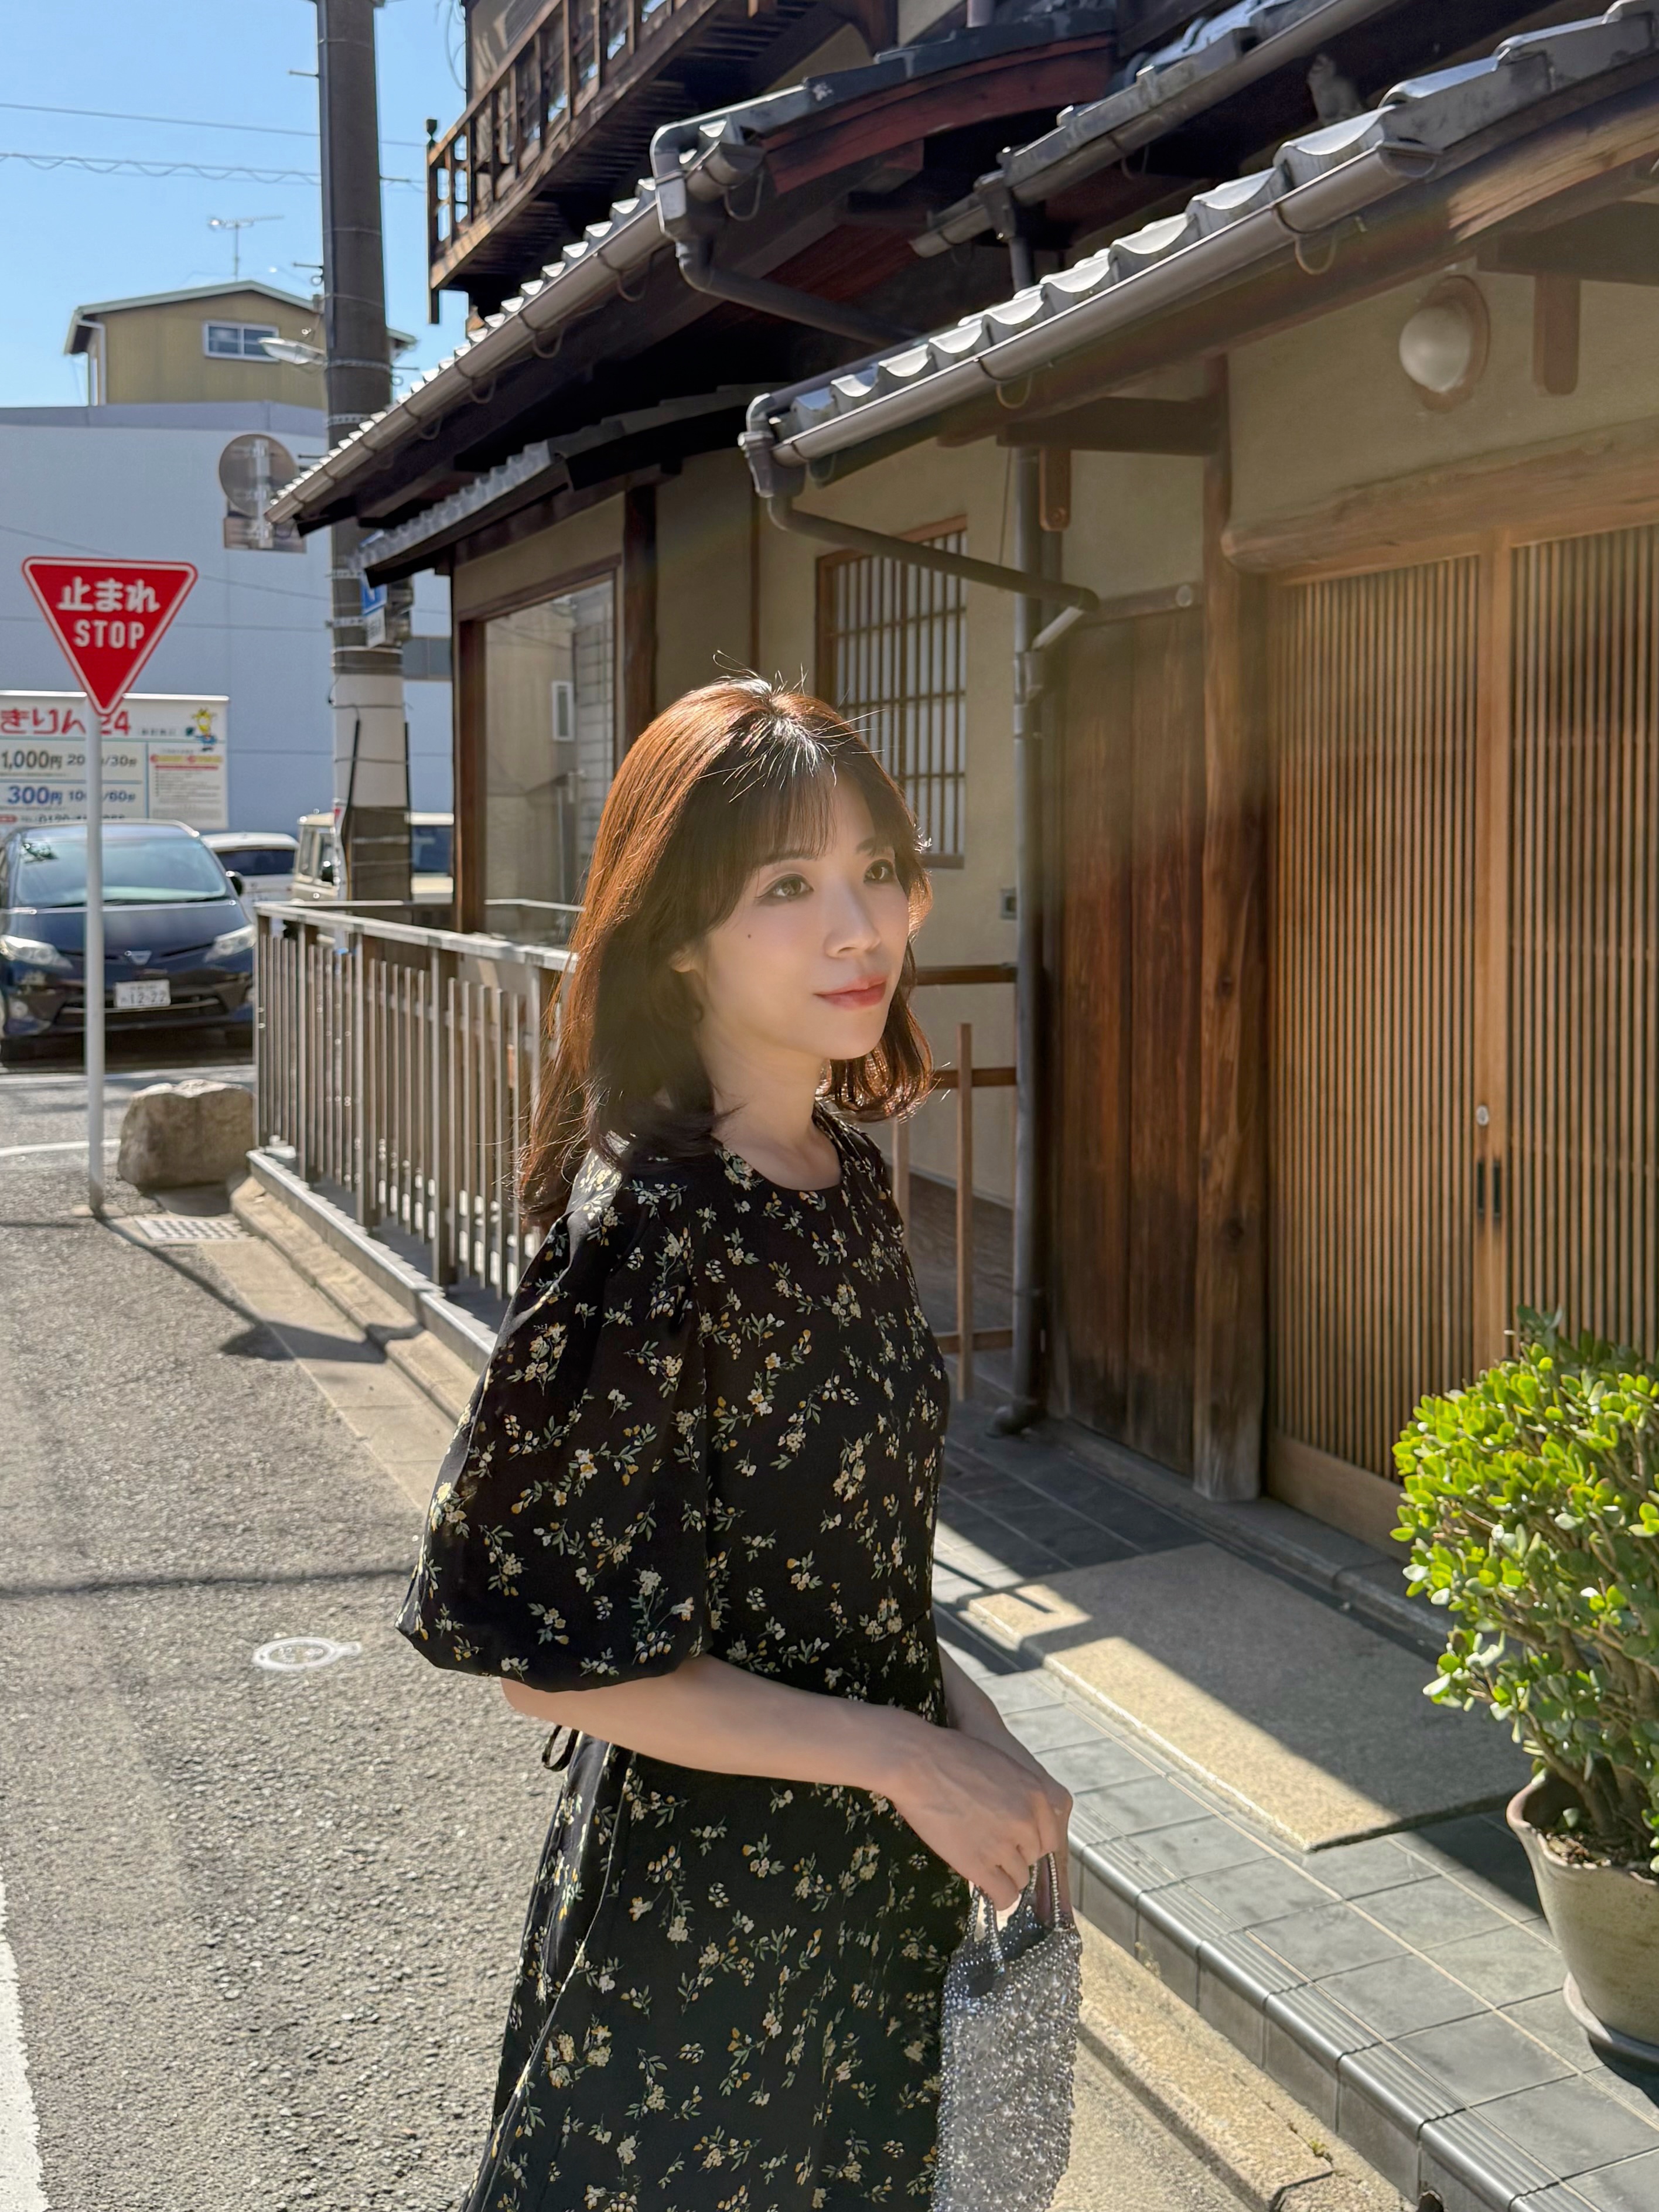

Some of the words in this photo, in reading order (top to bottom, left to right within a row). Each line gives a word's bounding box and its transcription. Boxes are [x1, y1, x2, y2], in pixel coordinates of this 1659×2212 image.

[57, 576, 161, 613] 止まれ
[74, 619, 145, 649] STOP
[1, 750, 62, 769] 1,000円
[8, 786, 63, 804] 300円
